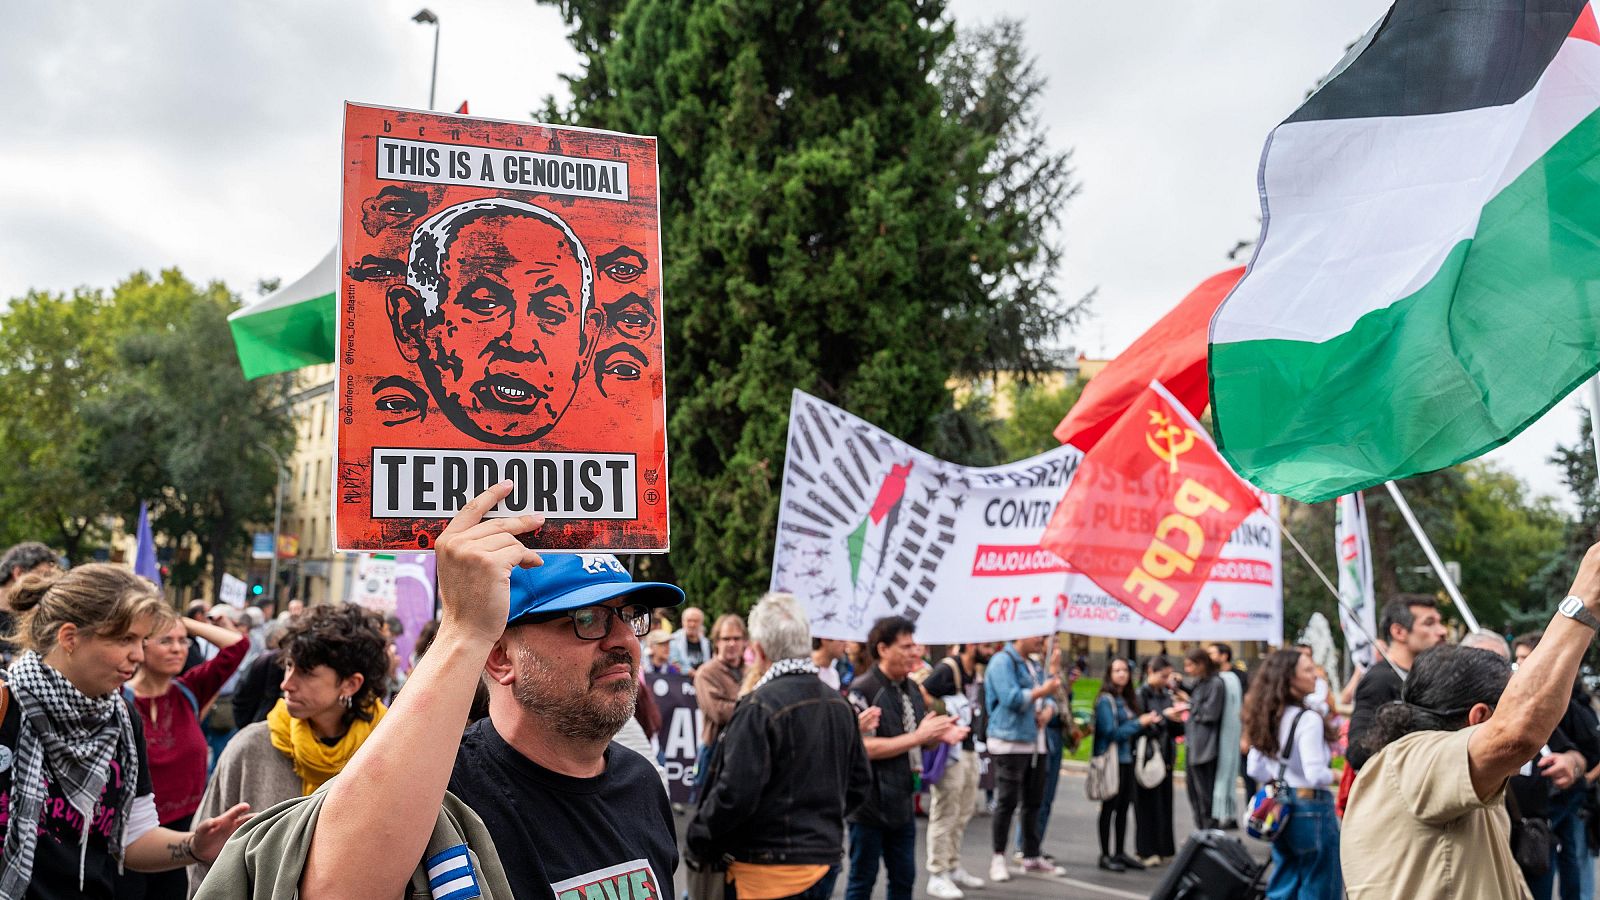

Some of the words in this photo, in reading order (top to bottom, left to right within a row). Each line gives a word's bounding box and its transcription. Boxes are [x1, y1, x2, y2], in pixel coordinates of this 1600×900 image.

[383, 143, 441, 178] THIS
[449, 150, 472, 180] IS
[480, 153, 495, 182] A
[503, 155, 623, 195] GENOCIDAL
[380, 455, 629, 513] TERRORIST
[1092, 503, 1154, 533] PUEB
[985, 597, 1021, 623] CRT
